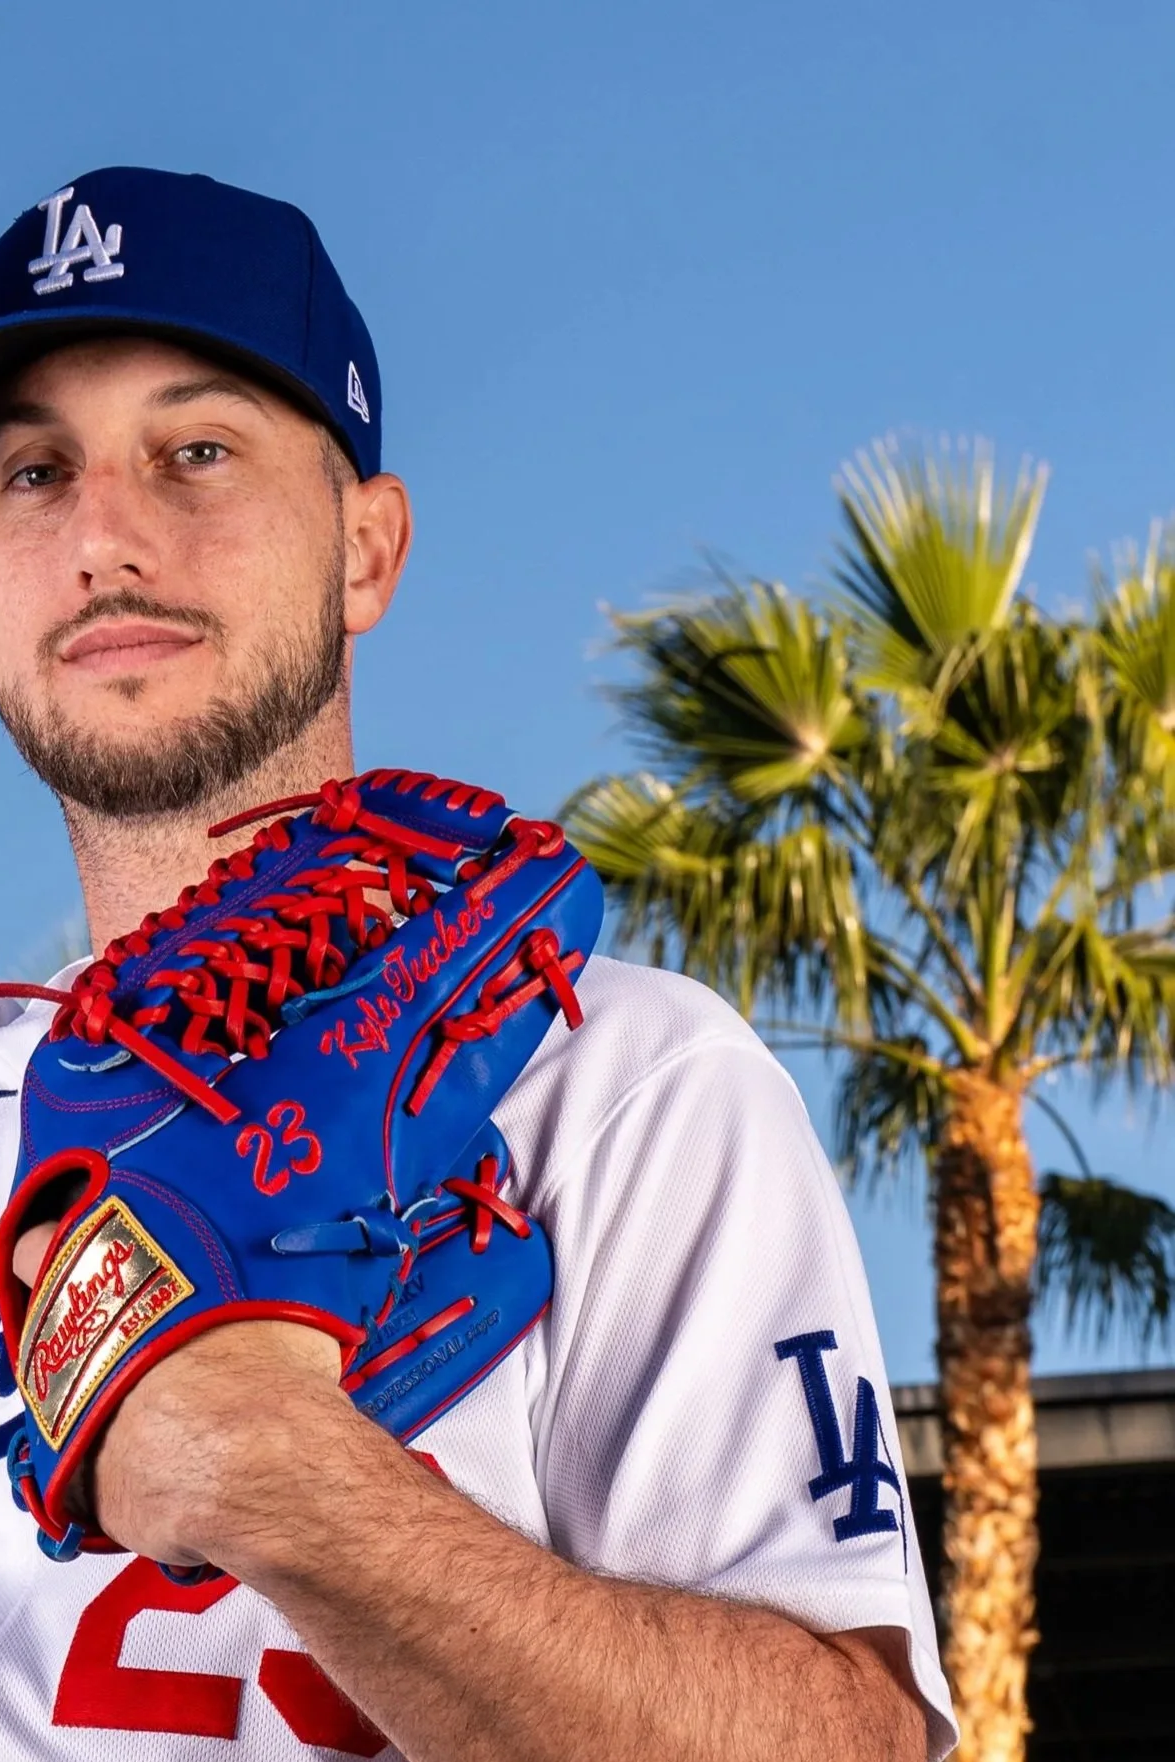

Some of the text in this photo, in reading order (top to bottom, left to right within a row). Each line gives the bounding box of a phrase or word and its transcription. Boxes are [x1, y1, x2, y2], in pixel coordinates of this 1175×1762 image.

[28, 186, 124, 296] LA
[318, 900, 495, 1070] Kyle Tucker
[235, 1100, 322, 1196] 23
[33, 1240, 135, 1402] Rawlings
[362, 1335, 466, 1418] ROFESSIONAL
[774, 1330, 908, 1575] LA
